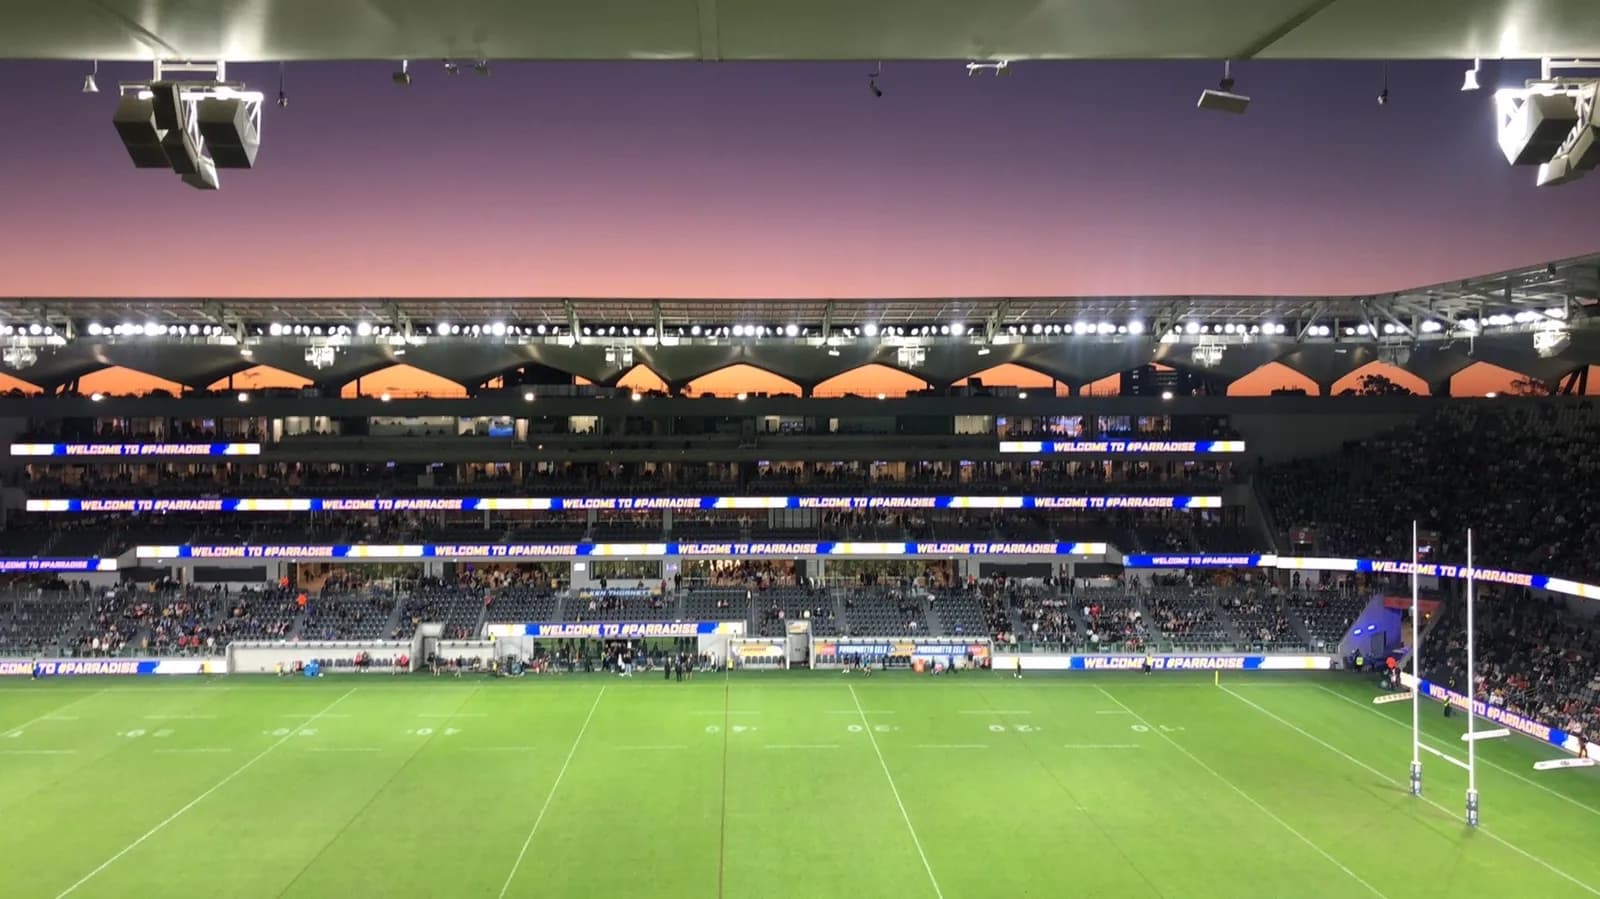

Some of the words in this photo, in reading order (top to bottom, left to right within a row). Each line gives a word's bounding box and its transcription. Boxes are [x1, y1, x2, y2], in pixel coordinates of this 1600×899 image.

[66, 444, 121, 455] WELCOME
[125, 444, 140, 455] TO
[140, 444, 211, 455] #PARRADISE
[1053, 442, 1108, 452] WELCOME
[1110, 442, 1126, 452] TO
[1126, 441, 1196, 452] #PARRADISE
[81, 500, 135, 510] WELCOME
[138, 500, 153, 510] TO
[153, 499, 223, 510] #PARRADISE
[322, 499, 375, 510] WELCOME
[378, 499, 393, 510] TO
[394, 499, 463, 509] #PARRADISE
[562, 498, 616, 508] WELCOME
[617, 498, 632, 508] TO
[633, 498, 702, 508] #PARRADISE
[799, 497, 851, 508] WELCOME
[853, 497, 868, 508] TO
[868, 497, 936, 507] #PARRADISE
[1034, 497, 1088, 508] WELCOME
[1090, 497, 1105, 508] TO
[1106, 497, 1174, 507] #PARRADISE
[191, 547, 246, 557] WELCOME
[248, 546, 264, 557] TO
[264, 546, 334, 557] #PARRADISE
[434, 546, 490, 557] WELCOME
[492, 545, 507, 557] TO
[508, 545, 578, 556] #PARRADISE
[678, 545, 733, 556] WELCOME
[734, 544, 749, 555] TO
[750, 544, 818, 555] #PARRADISE
[917, 543, 971, 555] WELCOME
[972, 543, 988, 555] TO
[989, 543, 1057, 554] #PARRADISE
[0, 560, 27, 569] LCOME
[1152, 557, 1191, 565] WELCOME
[1191, 557, 1202, 565] TO
[1202, 556, 1250, 565] #PARRADISE
[1371, 561, 1437, 576] WELCOME
[1440, 565, 1457, 577] TO
[1458, 566, 1533, 586] #PARRADISE
[539, 623, 600, 636] WELCOME
[603, 623, 619, 636] TO
[620, 622, 699, 636] #PARRADISE
[38, 661, 56, 674] TO
[57, 661, 139, 673] #PARRADISE
[1084, 657, 1146, 669] WELCOME
[1166, 656, 1245, 668] #PARRADISE
[1473, 700, 1486, 715] TO
[1487, 704, 1550, 741] #PARRADISE
